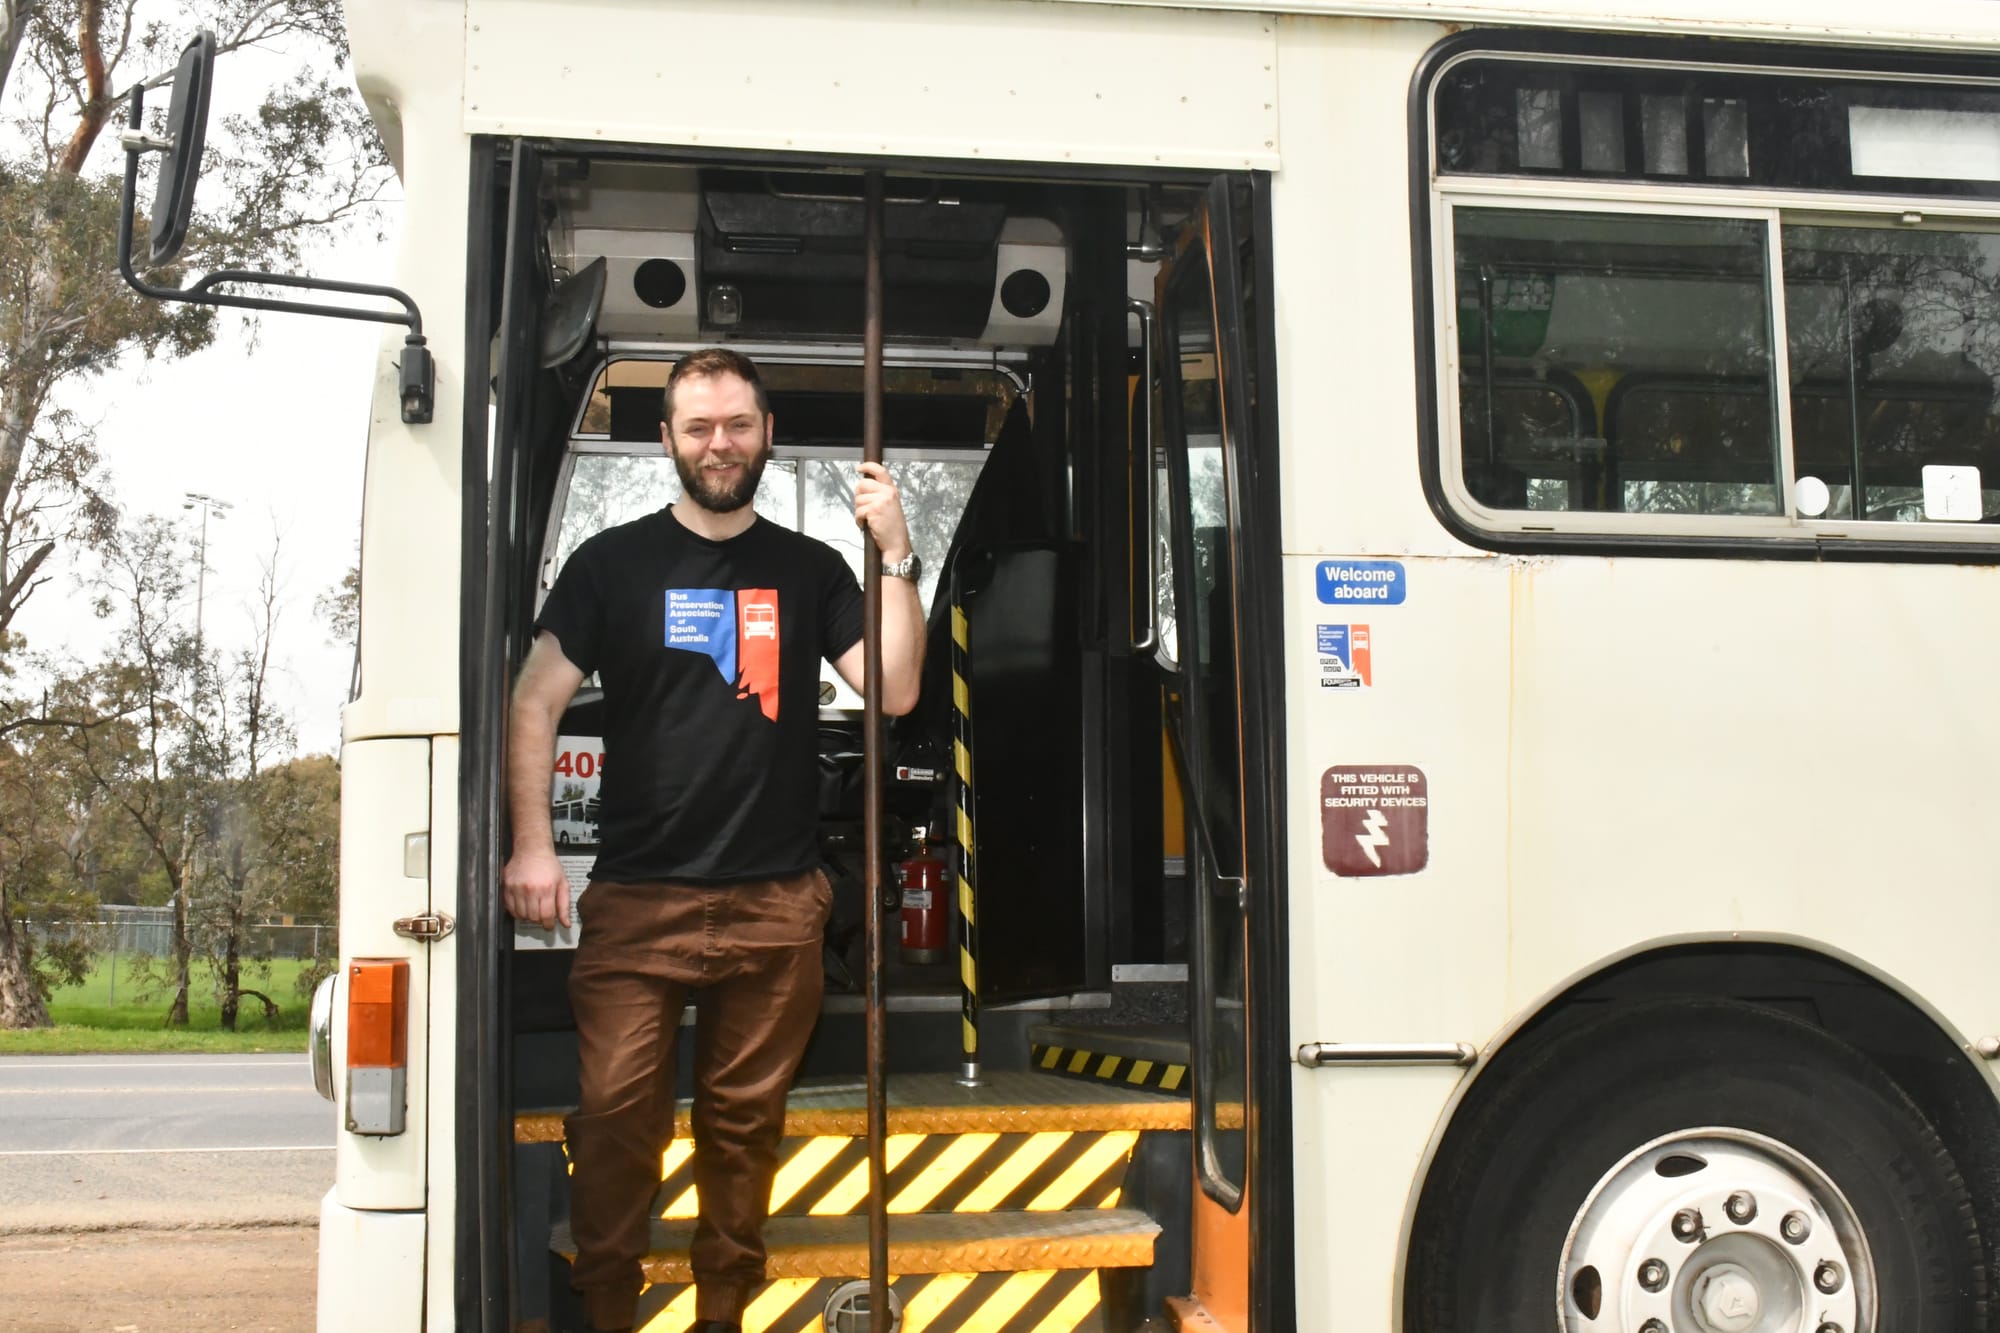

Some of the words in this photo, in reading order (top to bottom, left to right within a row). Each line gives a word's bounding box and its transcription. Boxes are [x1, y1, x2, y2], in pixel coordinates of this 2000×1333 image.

[1325, 566, 1396, 582] Welcome
[670, 592, 688, 600] Bus
[1334, 584, 1388, 599] aboard
[670, 601, 724, 610] Preservation
[670, 610, 720, 618] Association
[670, 625, 697, 634] South
[670, 634, 709, 643] Australia
[1331, 774, 1357, 783] THIS
[1360, 774, 1405, 783] VEHICLE
[1408, 774, 1419, 783] IS
[1341, 786, 1379, 795] FITTED
[1381, 786, 1410, 795] WITH
[1325, 798, 1378, 807] SECURITY
[1381, 798, 1427, 807] DEVICES
